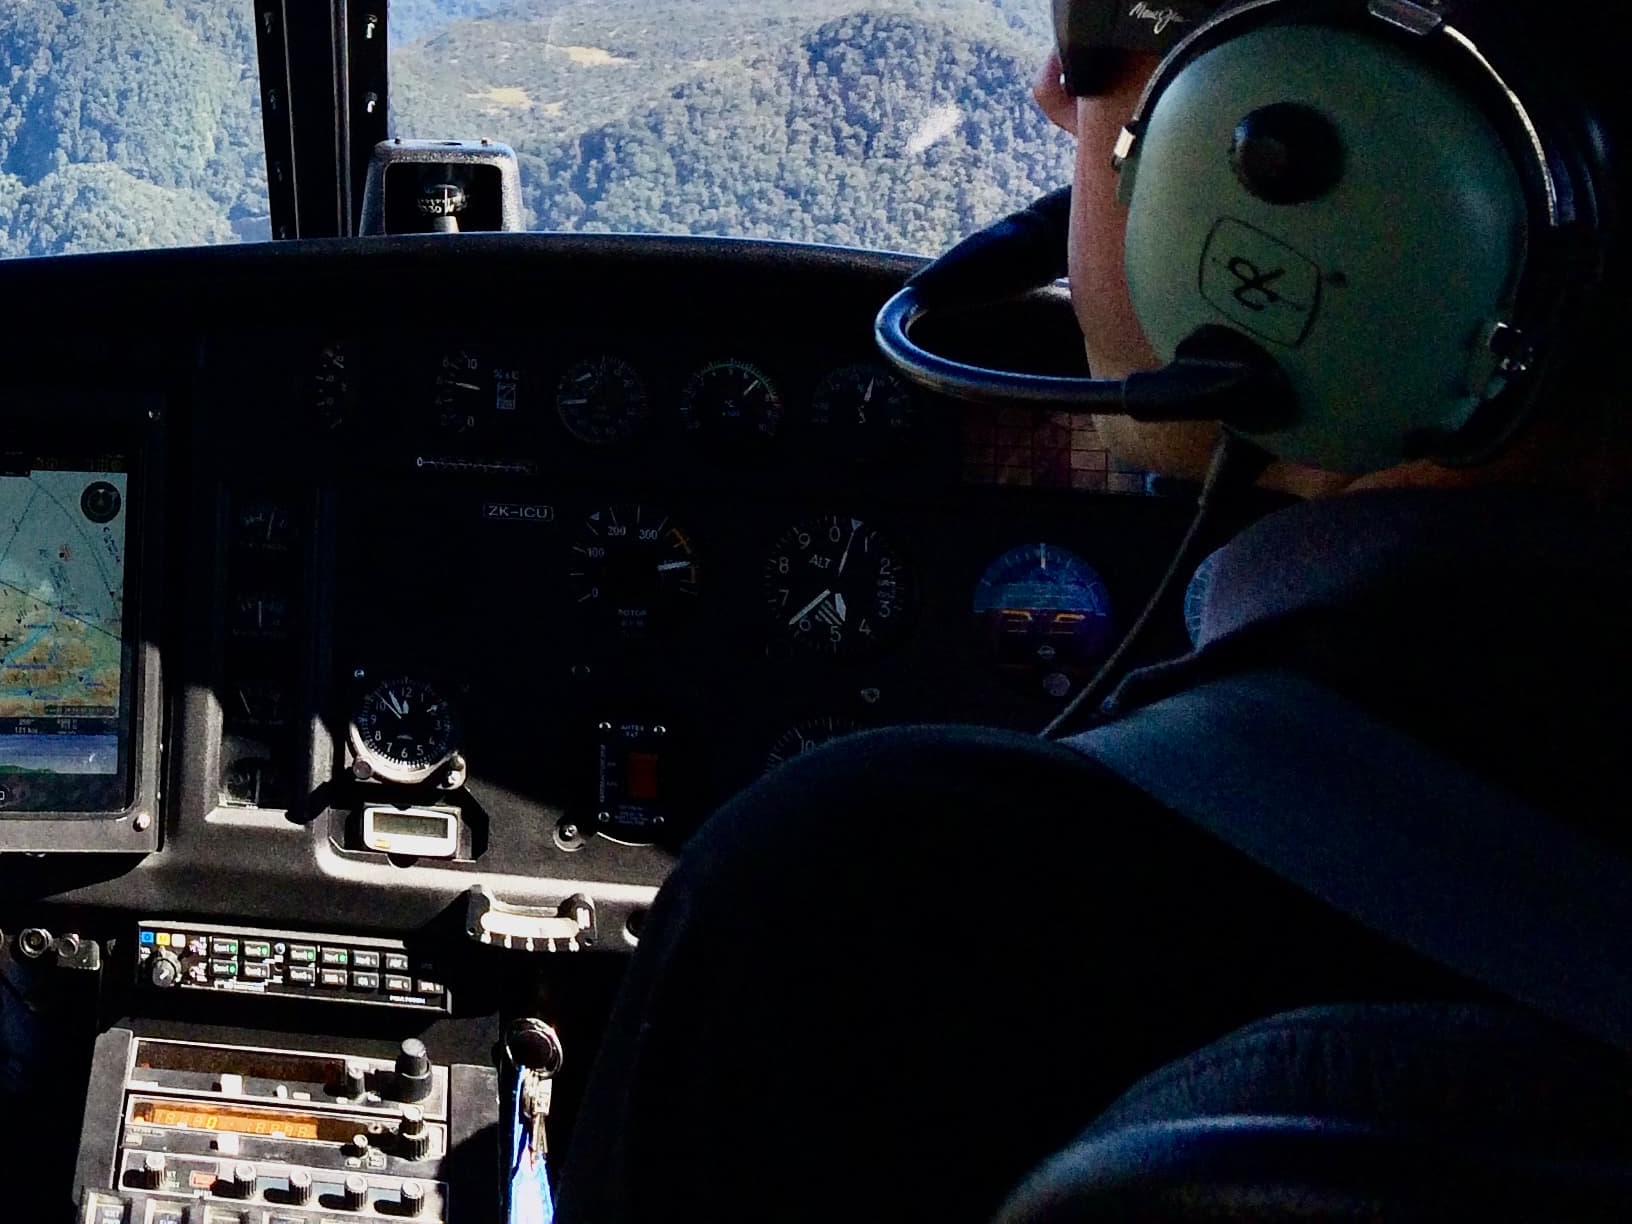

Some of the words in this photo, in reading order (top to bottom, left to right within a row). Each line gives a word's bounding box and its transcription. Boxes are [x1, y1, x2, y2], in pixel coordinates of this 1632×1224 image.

[488, 505, 548, 519] ZK-ICU
[639, 529, 658, 540] 300
[798, 533, 811, 550] 9
[829, 526, 841, 543] 0
[587, 547, 605, 559] 100
[778, 556, 790, 574] 8
[808, 554, 832, 569] ALT
[880, 557, 891, 575] 2
[778, 588, 789, 607] 7
[879, 600, 891, 618] 3
[830, 626, 842, 643] 5
[858, 618, 872, 636] 4
[401, 686, 414, 698] 12
[374, 730, 382, 741] 8
[386, 742, 393, 754] 7
[401, 747, 408, 758] 6
[416, 745, 424, 756] 5
